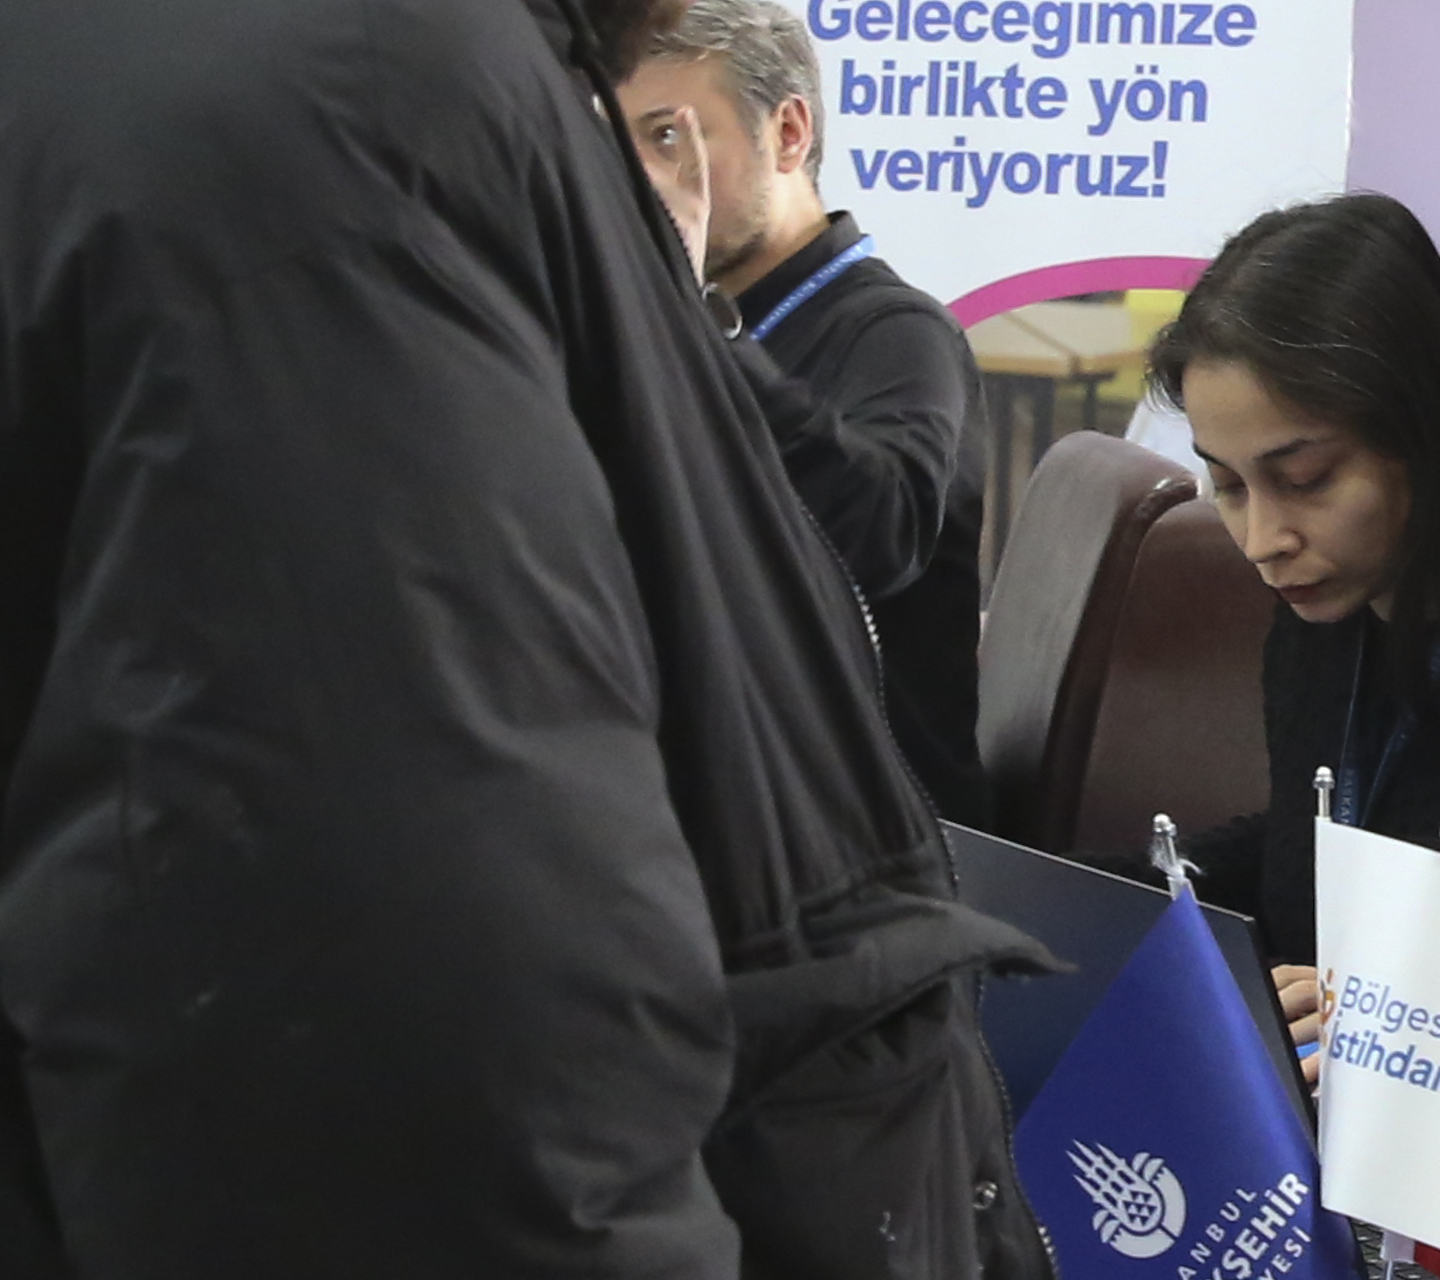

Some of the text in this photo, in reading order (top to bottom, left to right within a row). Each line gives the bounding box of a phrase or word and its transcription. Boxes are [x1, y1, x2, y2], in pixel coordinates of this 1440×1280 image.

[838, 59, 1209, 136] birlikte yön
[849, 136, 1170, 209] veriyoruz!
